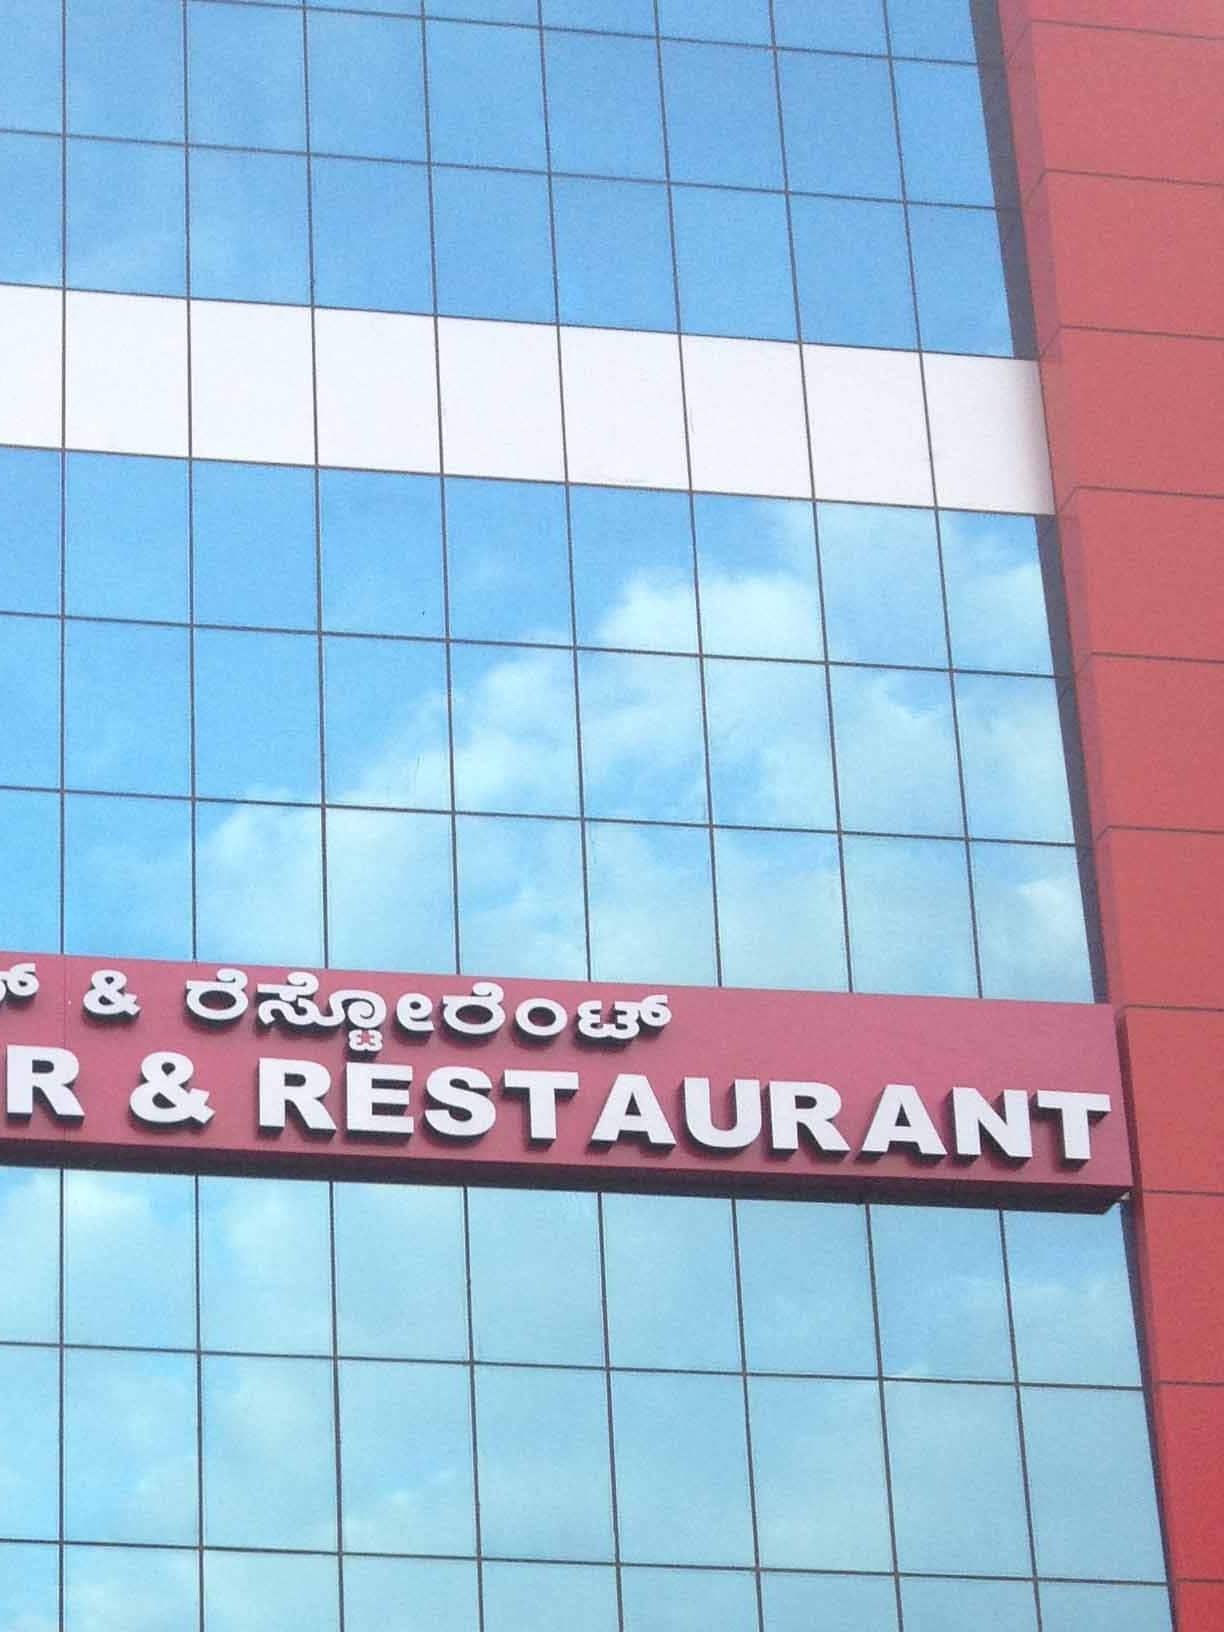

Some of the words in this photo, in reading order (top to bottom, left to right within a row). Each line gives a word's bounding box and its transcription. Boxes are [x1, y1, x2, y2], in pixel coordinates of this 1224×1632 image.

[82, 969, 142, 1017] &
[129, 1051, 216, 1126] &
[259, 1057, 1112, 1163] RESTAURANT
